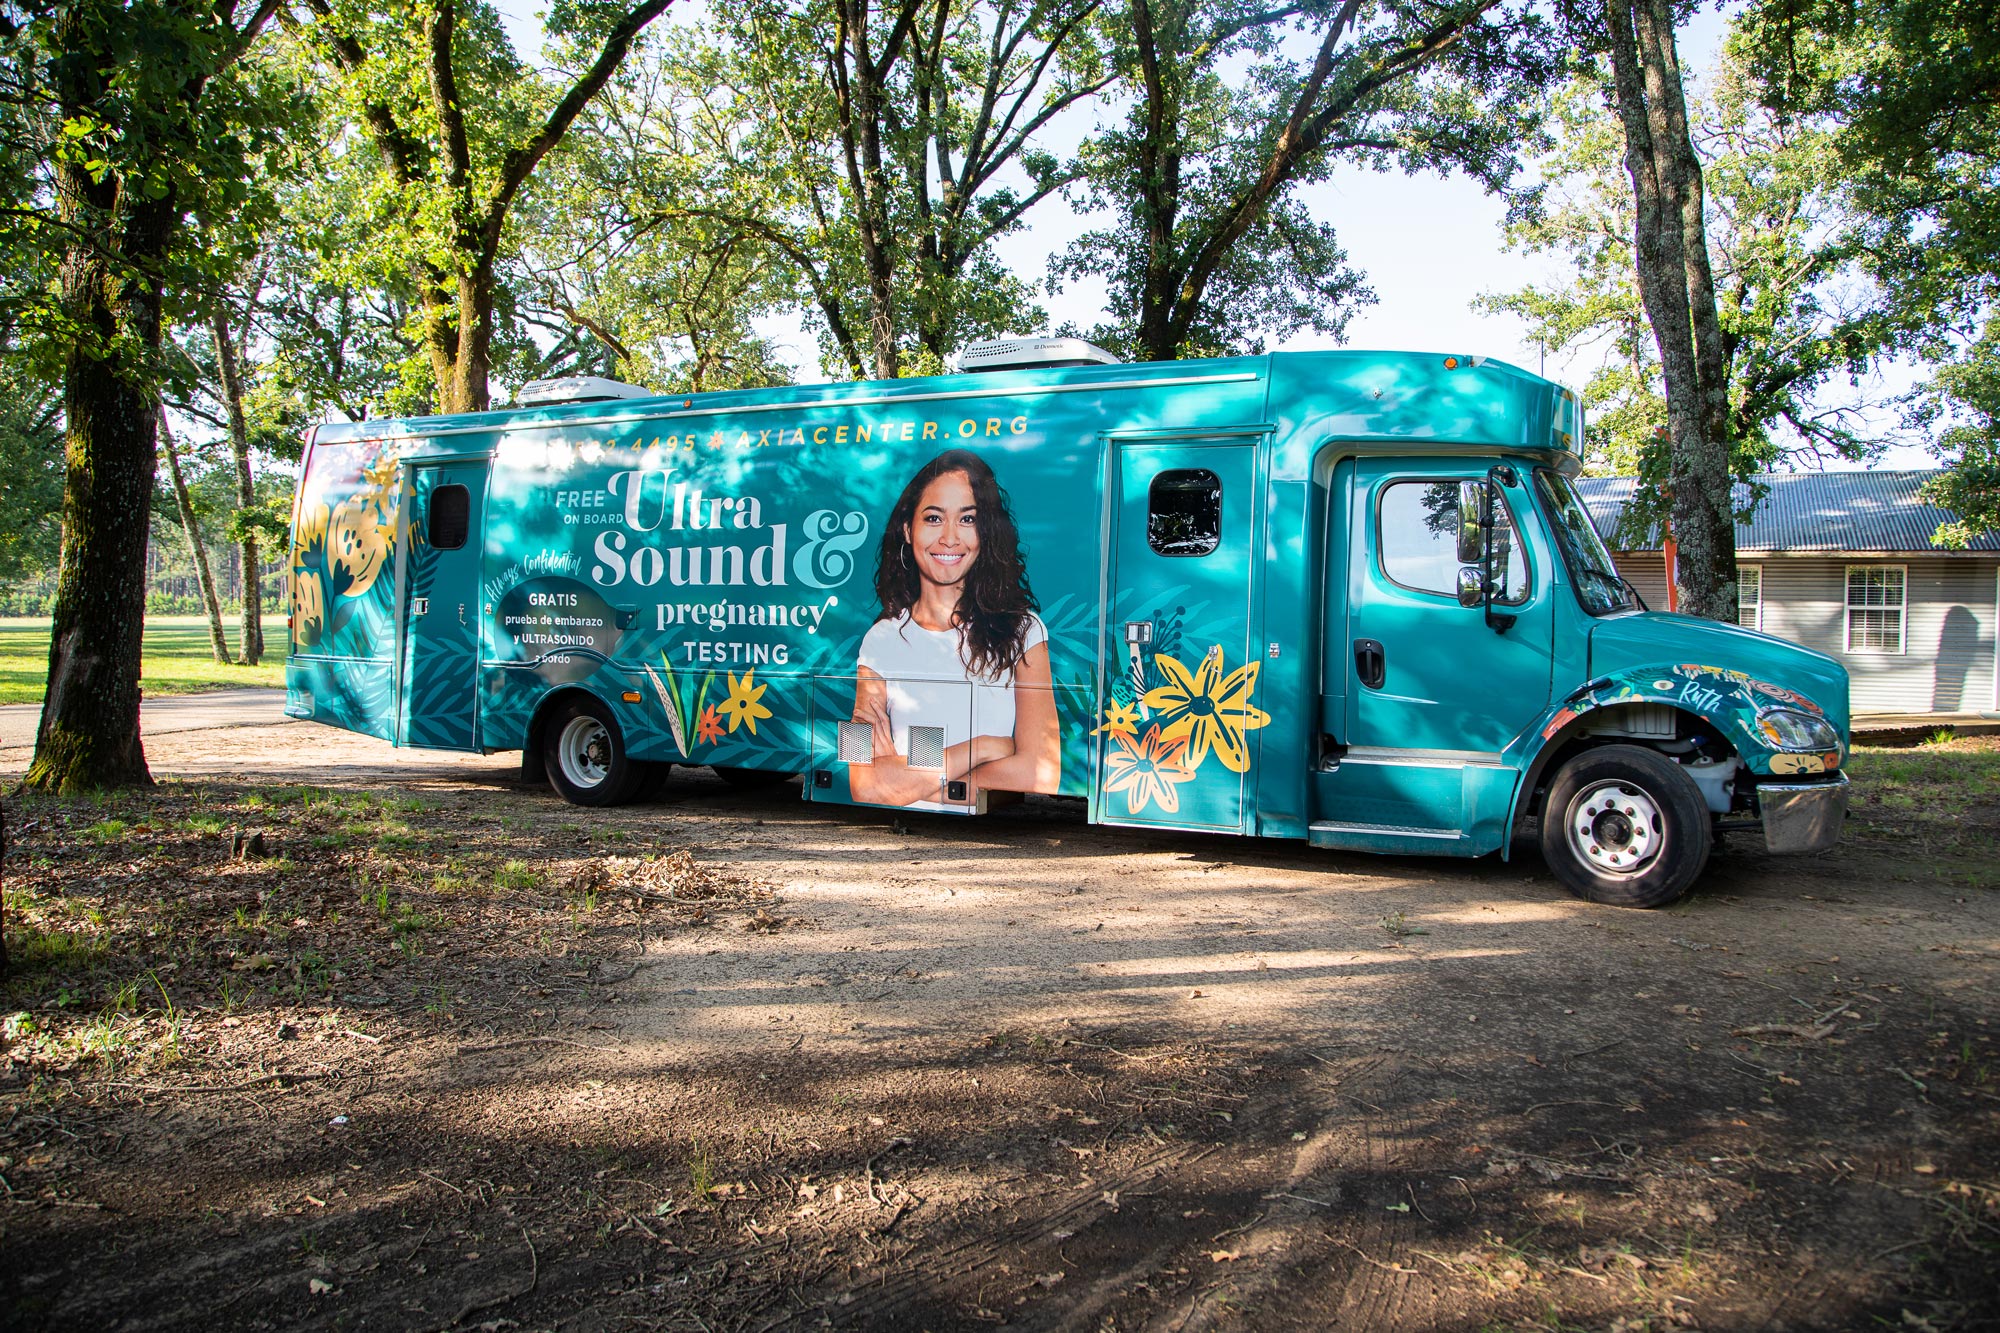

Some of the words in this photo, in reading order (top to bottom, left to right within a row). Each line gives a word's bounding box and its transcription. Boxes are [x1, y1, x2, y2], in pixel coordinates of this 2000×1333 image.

[735, 415, 1029, 450] AXIACENTER.ORG
[555, 489, 605, 509] FREE
[607, 468, 765, 532] Ultra
[563, 514, 582, 525] ON
[583, 512, 624, 525] BOARD
[591, 523, 789, 588] Sound
[792, 509, 869, 589] &
[484, 562, 521, 603] Always
[523, 548, 582, 576] Confidential
[528, 592, 578, 607] GRATIS
[505, 615, 537, 626] prueba
[540, 615, 553, 625] de
[554, 616, 603, 627] embarazo
[656, 595, 839, 635] pregnancy
[513, 635, 520, 645] y
[522, 633, 594, 646] ULTRASONIDO
[683, 641, 789, 665] TESTING
[1679, 680, 1722, 713] Ruth
